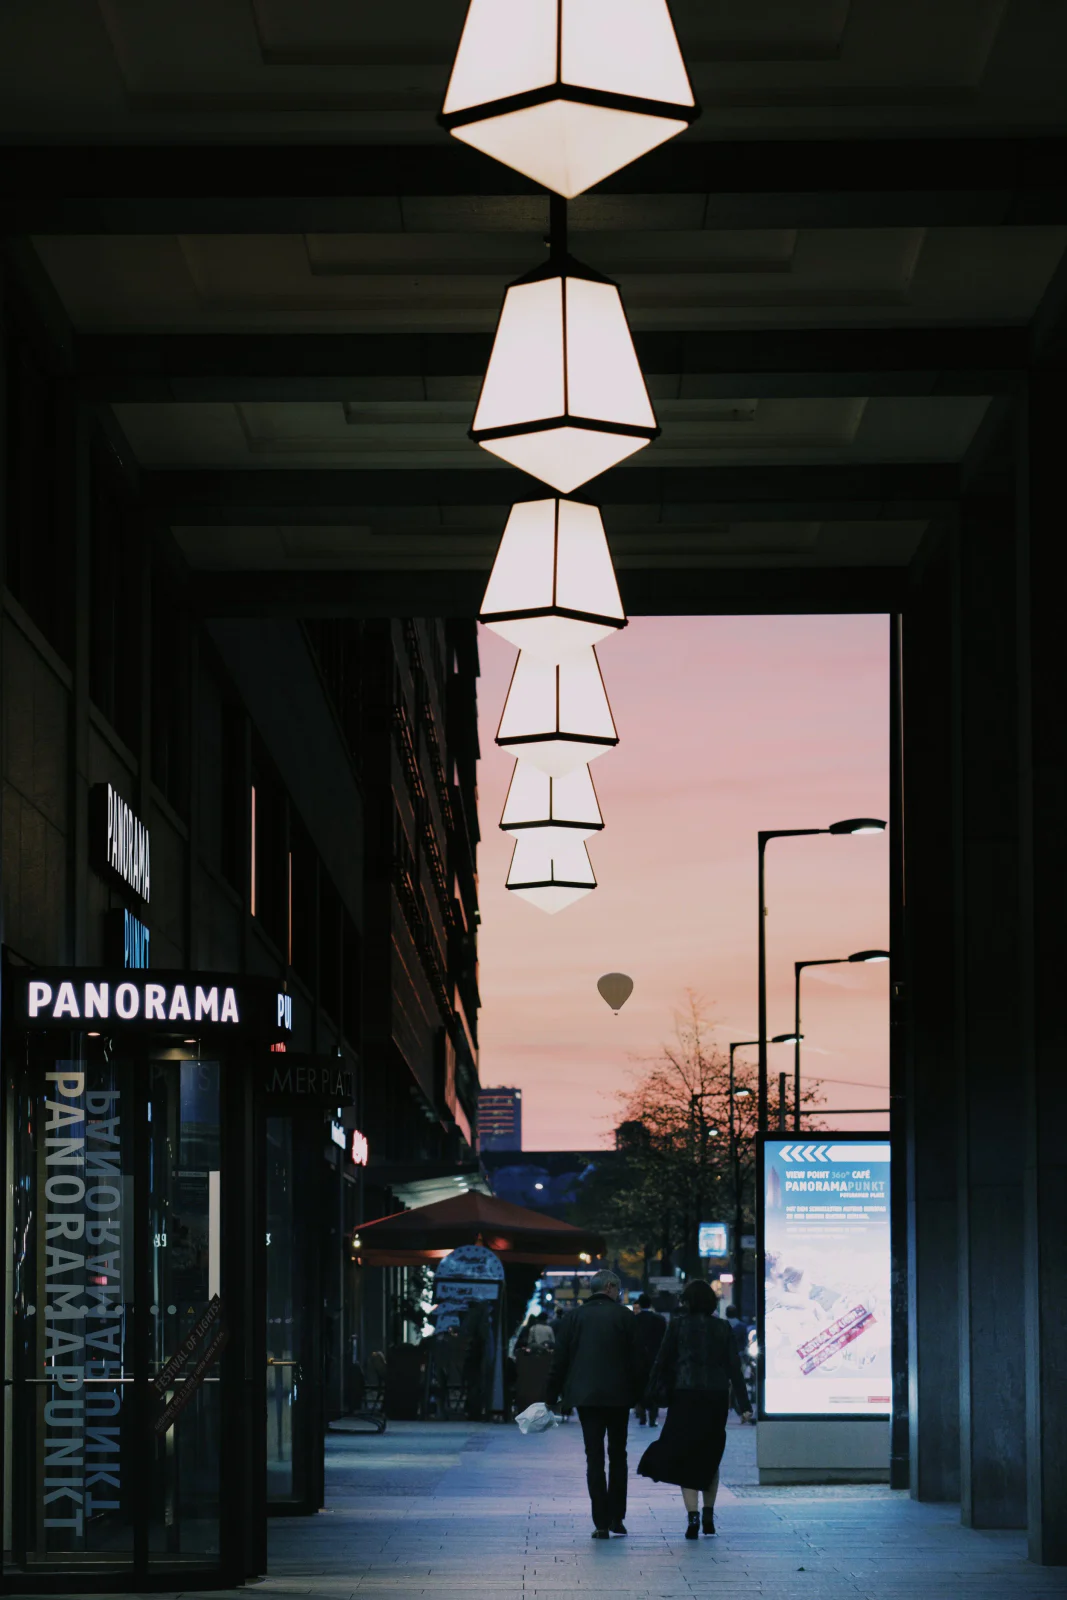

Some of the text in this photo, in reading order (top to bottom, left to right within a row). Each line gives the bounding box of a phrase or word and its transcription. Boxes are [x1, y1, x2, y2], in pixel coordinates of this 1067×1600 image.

[107, 782, 150, 904] PANORAMA
[124, 907, 150, 969] PUNKT
[28, 981, 239, 1023] PANORAMA
[785, 1181, 885, 1192] PANORAMAPUNKT
[786, 1171, 805, 1179] VIEW
[807, 1171, 830, 1179] POINT
[852, 1170, 870, 1179] CAFÉ
[43, 1071, 85, 1536] PANORAMAPUNKT
[154, 1349, 189, 1393] FESTIVAL
[186, 1334, 198, 1351] OF
